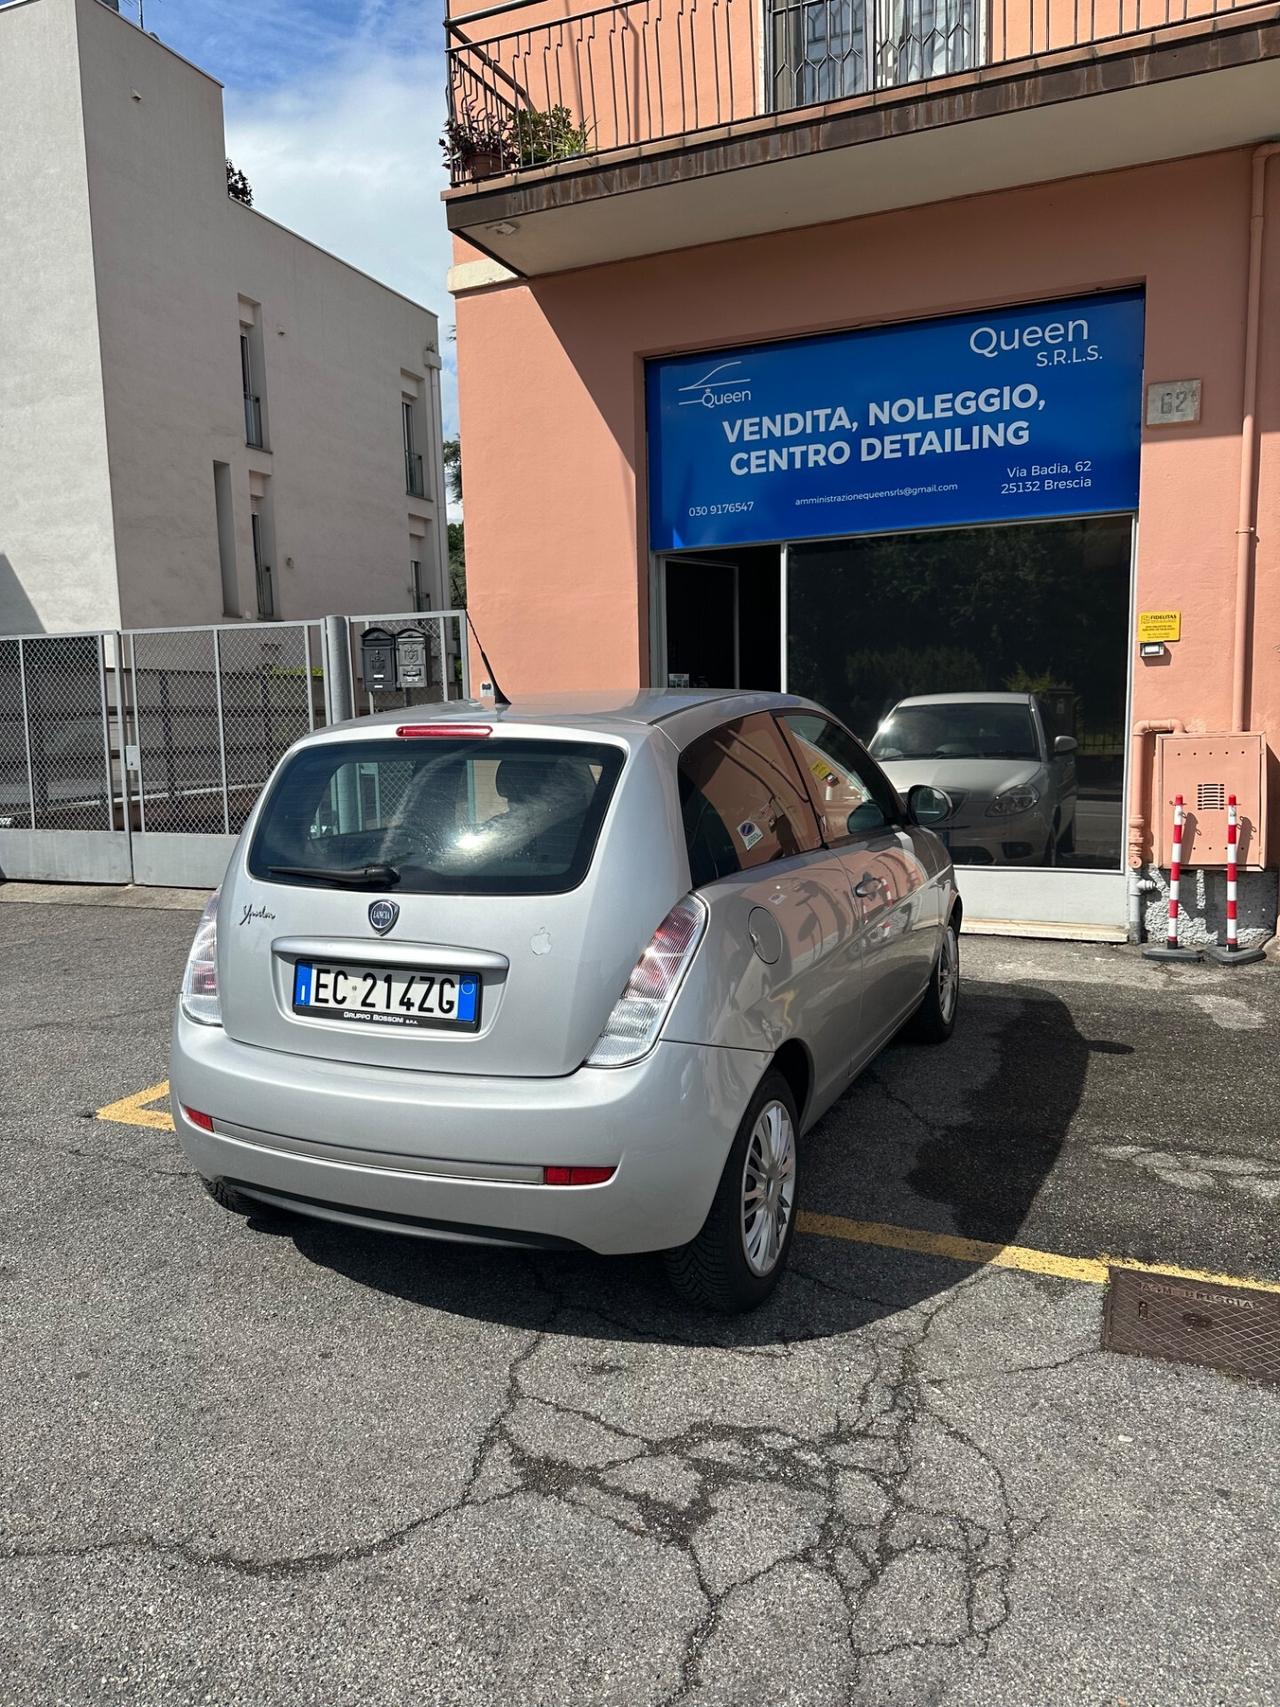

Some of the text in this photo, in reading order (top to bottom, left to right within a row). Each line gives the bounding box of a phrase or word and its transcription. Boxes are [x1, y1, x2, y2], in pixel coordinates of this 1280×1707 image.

[970, 319, 1089, 358] Queen
[1036, 345, 1103, 367] S.R.L.S.
[701, 390, 752, 408] Queen
[722, 383, 1046, 443] VENDITA, NOLEGGIO,
[730, 420, 1030, 476] CENTRO DETAILING
[1007, 460, 1092, 478] Via Badia, 62
[794, 482, 959, 506] amministrazionequeensrls@gmail.com
[1000, 476, 1092, 494] 25132 Brescia
[688, 501, 755, 517] 030 9176547
[373, 910, 390, 919] LANCIA
[314, 968, 349, 1005] EC
[360, 972, 456, 1014] 214ZG
